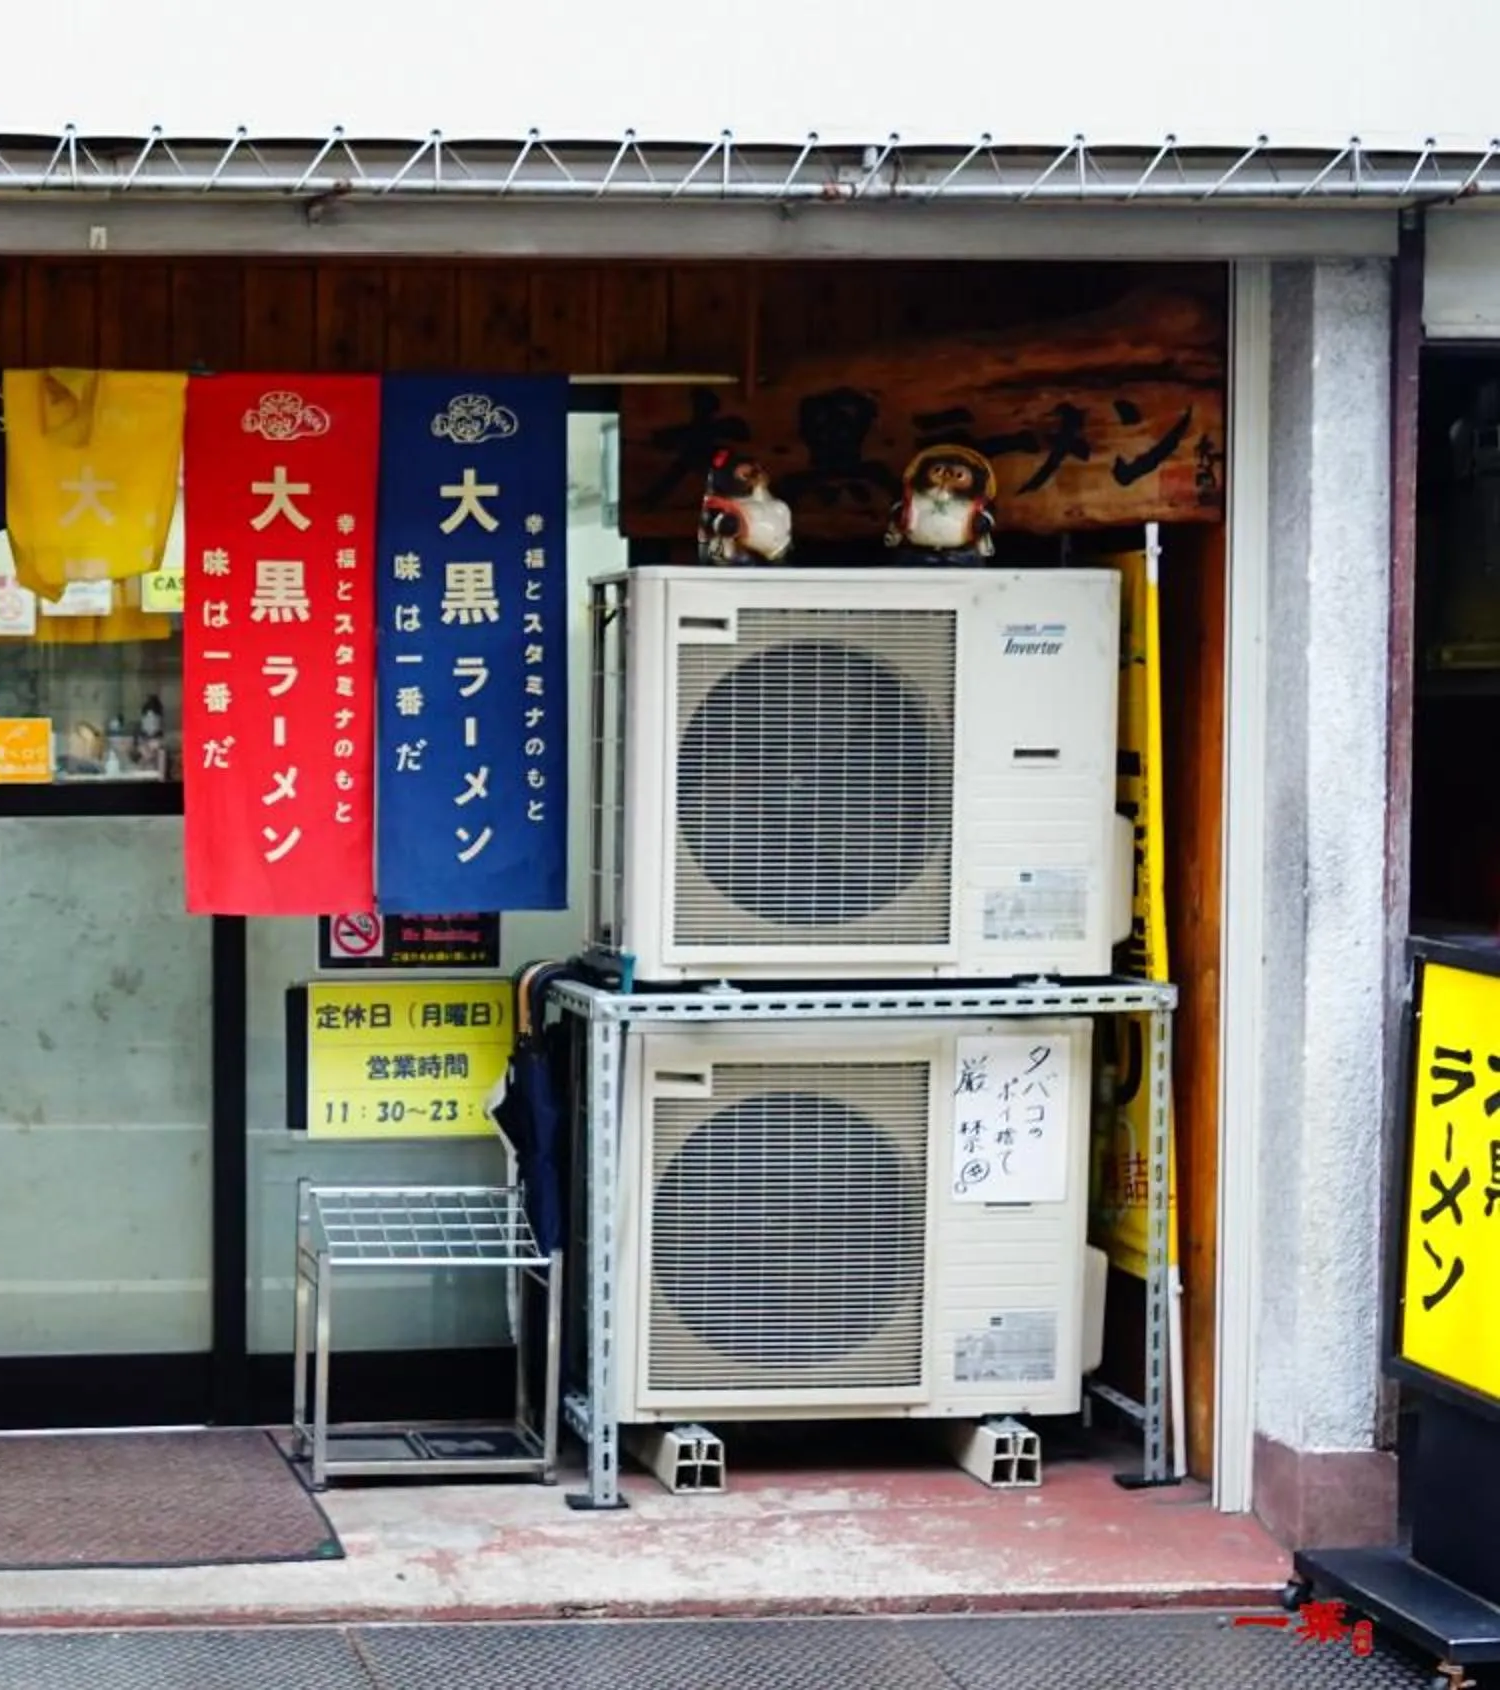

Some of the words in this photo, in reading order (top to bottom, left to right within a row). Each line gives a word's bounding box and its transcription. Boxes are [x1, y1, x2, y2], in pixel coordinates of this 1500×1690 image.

[59, 465, 118, 528] 大
[202, 547, 235, 770] 味は一番だ
[250, 465, 312, 863] 大黒ラーメン
[333, 513, 357, 823] 幸福とスタミナのもと
[393, 553, 426, 772] 味は一番だ
[439, 468, 500, 863] 大黒ラーメン
[522, 513, 546, 822] 幸福とスタミナのもと
[1003, 638, 1063, 656] Inverter
[366, 1053, 470, 1081] 営業時間
[1420, 1046, 1476, 1312] ラーメン
